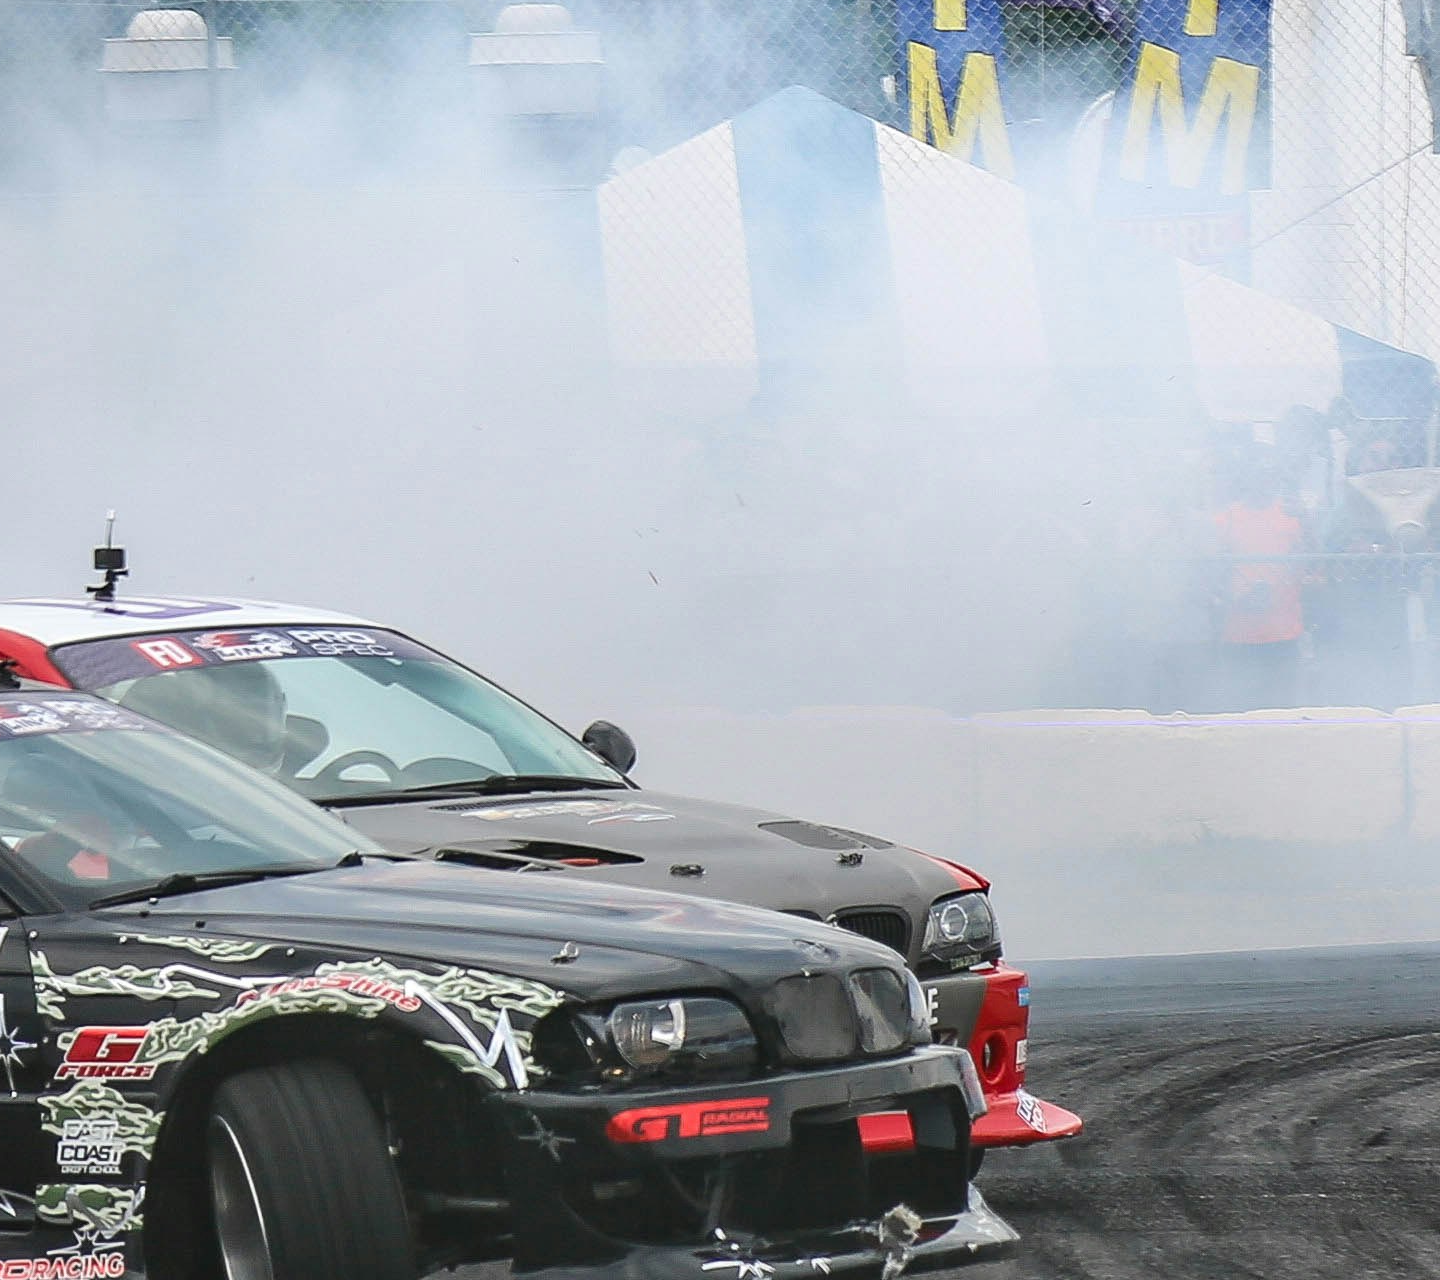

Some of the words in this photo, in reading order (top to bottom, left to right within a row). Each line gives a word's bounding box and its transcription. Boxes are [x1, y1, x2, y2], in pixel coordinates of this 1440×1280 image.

[288, 629, 376, 645] PRO
[310, 642, 395, 657] SPEC
[64, 1026, 150, 1063] G
[54, 1063, 159, 1080] FORCE
[605, 1096, 772, 1143] GT
[59, 1143, 121, 1163] COAST
